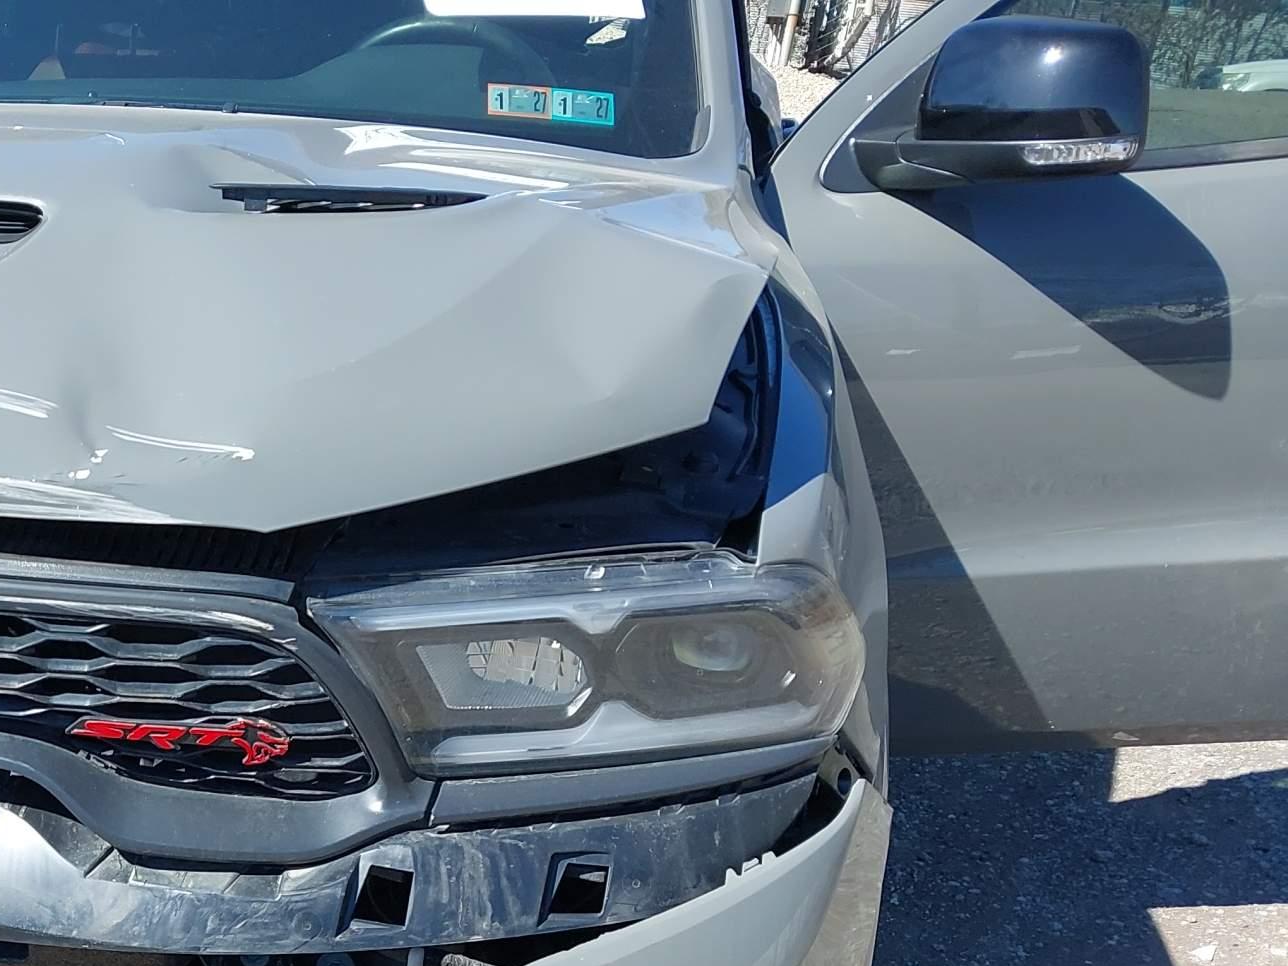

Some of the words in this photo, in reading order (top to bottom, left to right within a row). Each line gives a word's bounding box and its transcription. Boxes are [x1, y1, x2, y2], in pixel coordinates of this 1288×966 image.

[533, 91, 547, 114] 27
[595, 97, 610, 119] 27
[70, 719, 244, 750] SRT
